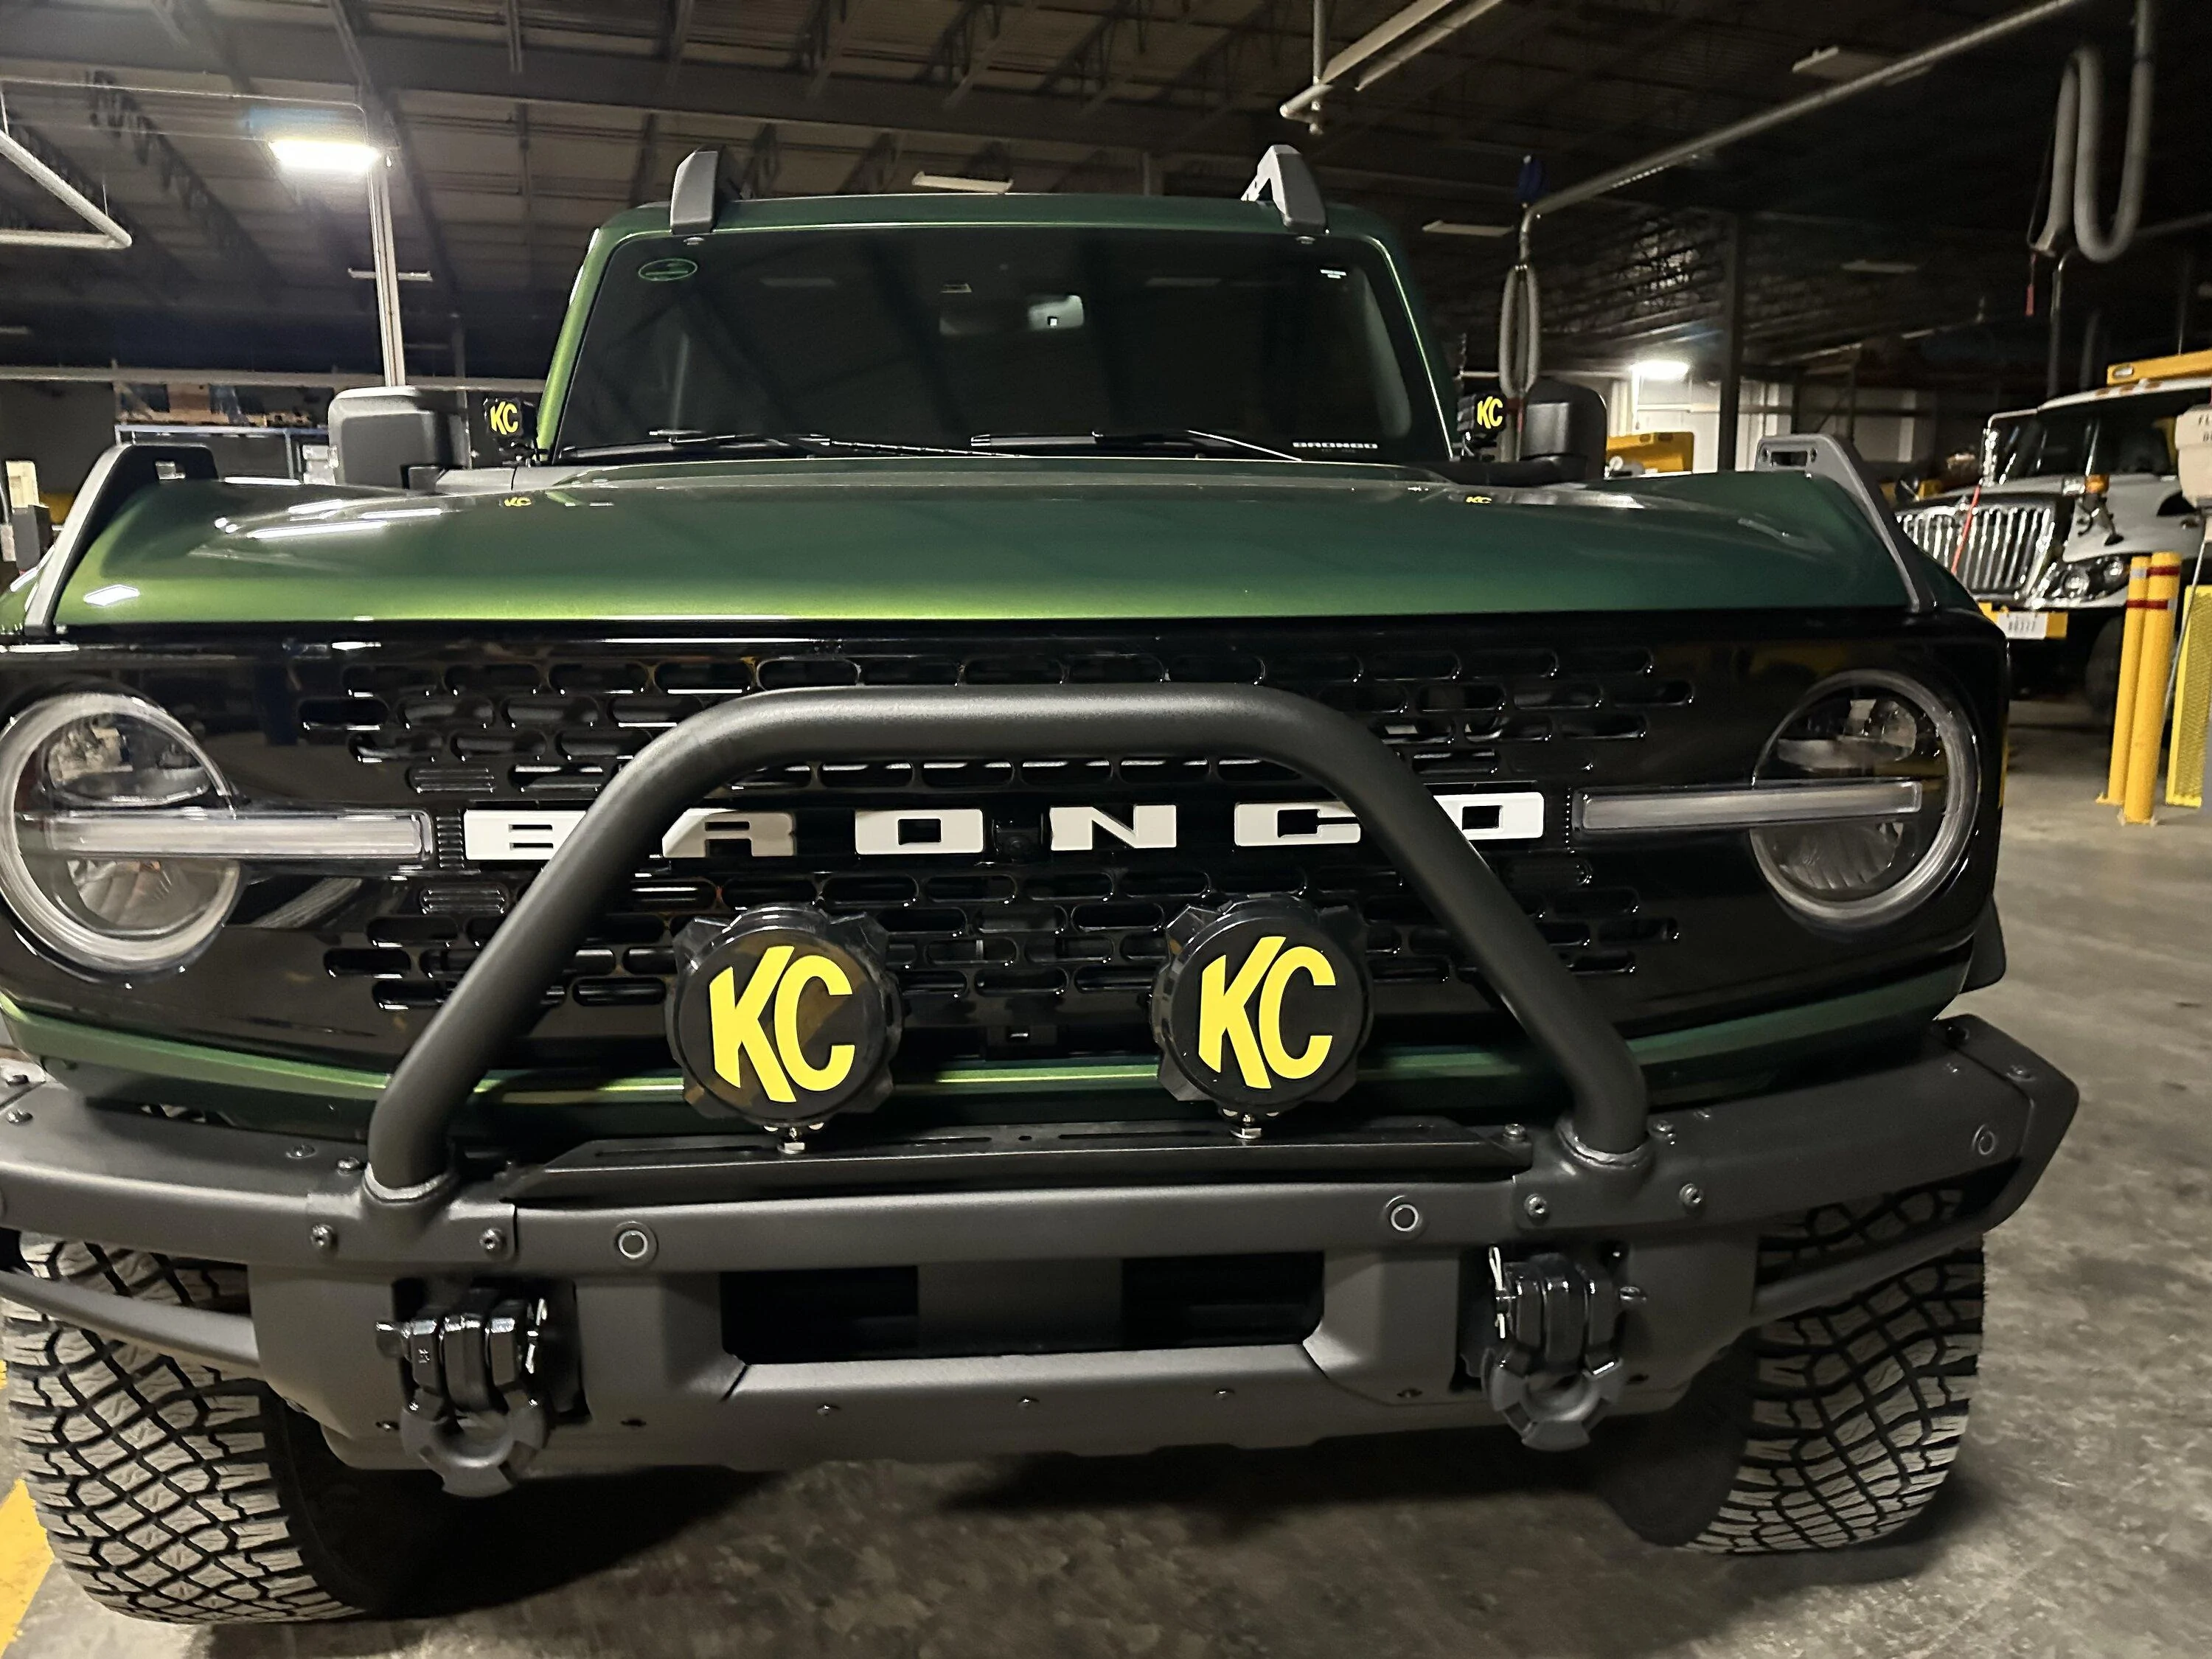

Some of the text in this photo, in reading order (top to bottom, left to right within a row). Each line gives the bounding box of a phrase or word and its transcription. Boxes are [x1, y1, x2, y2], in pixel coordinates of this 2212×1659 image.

[490, 401, 518, 435] KC
[1477, 396, 1503, 429] KC
[464, 791, 1545, 860] BRONCO
[709, 945, 855, 1102] KC
[1199, 936, 1336, 1089] KC
